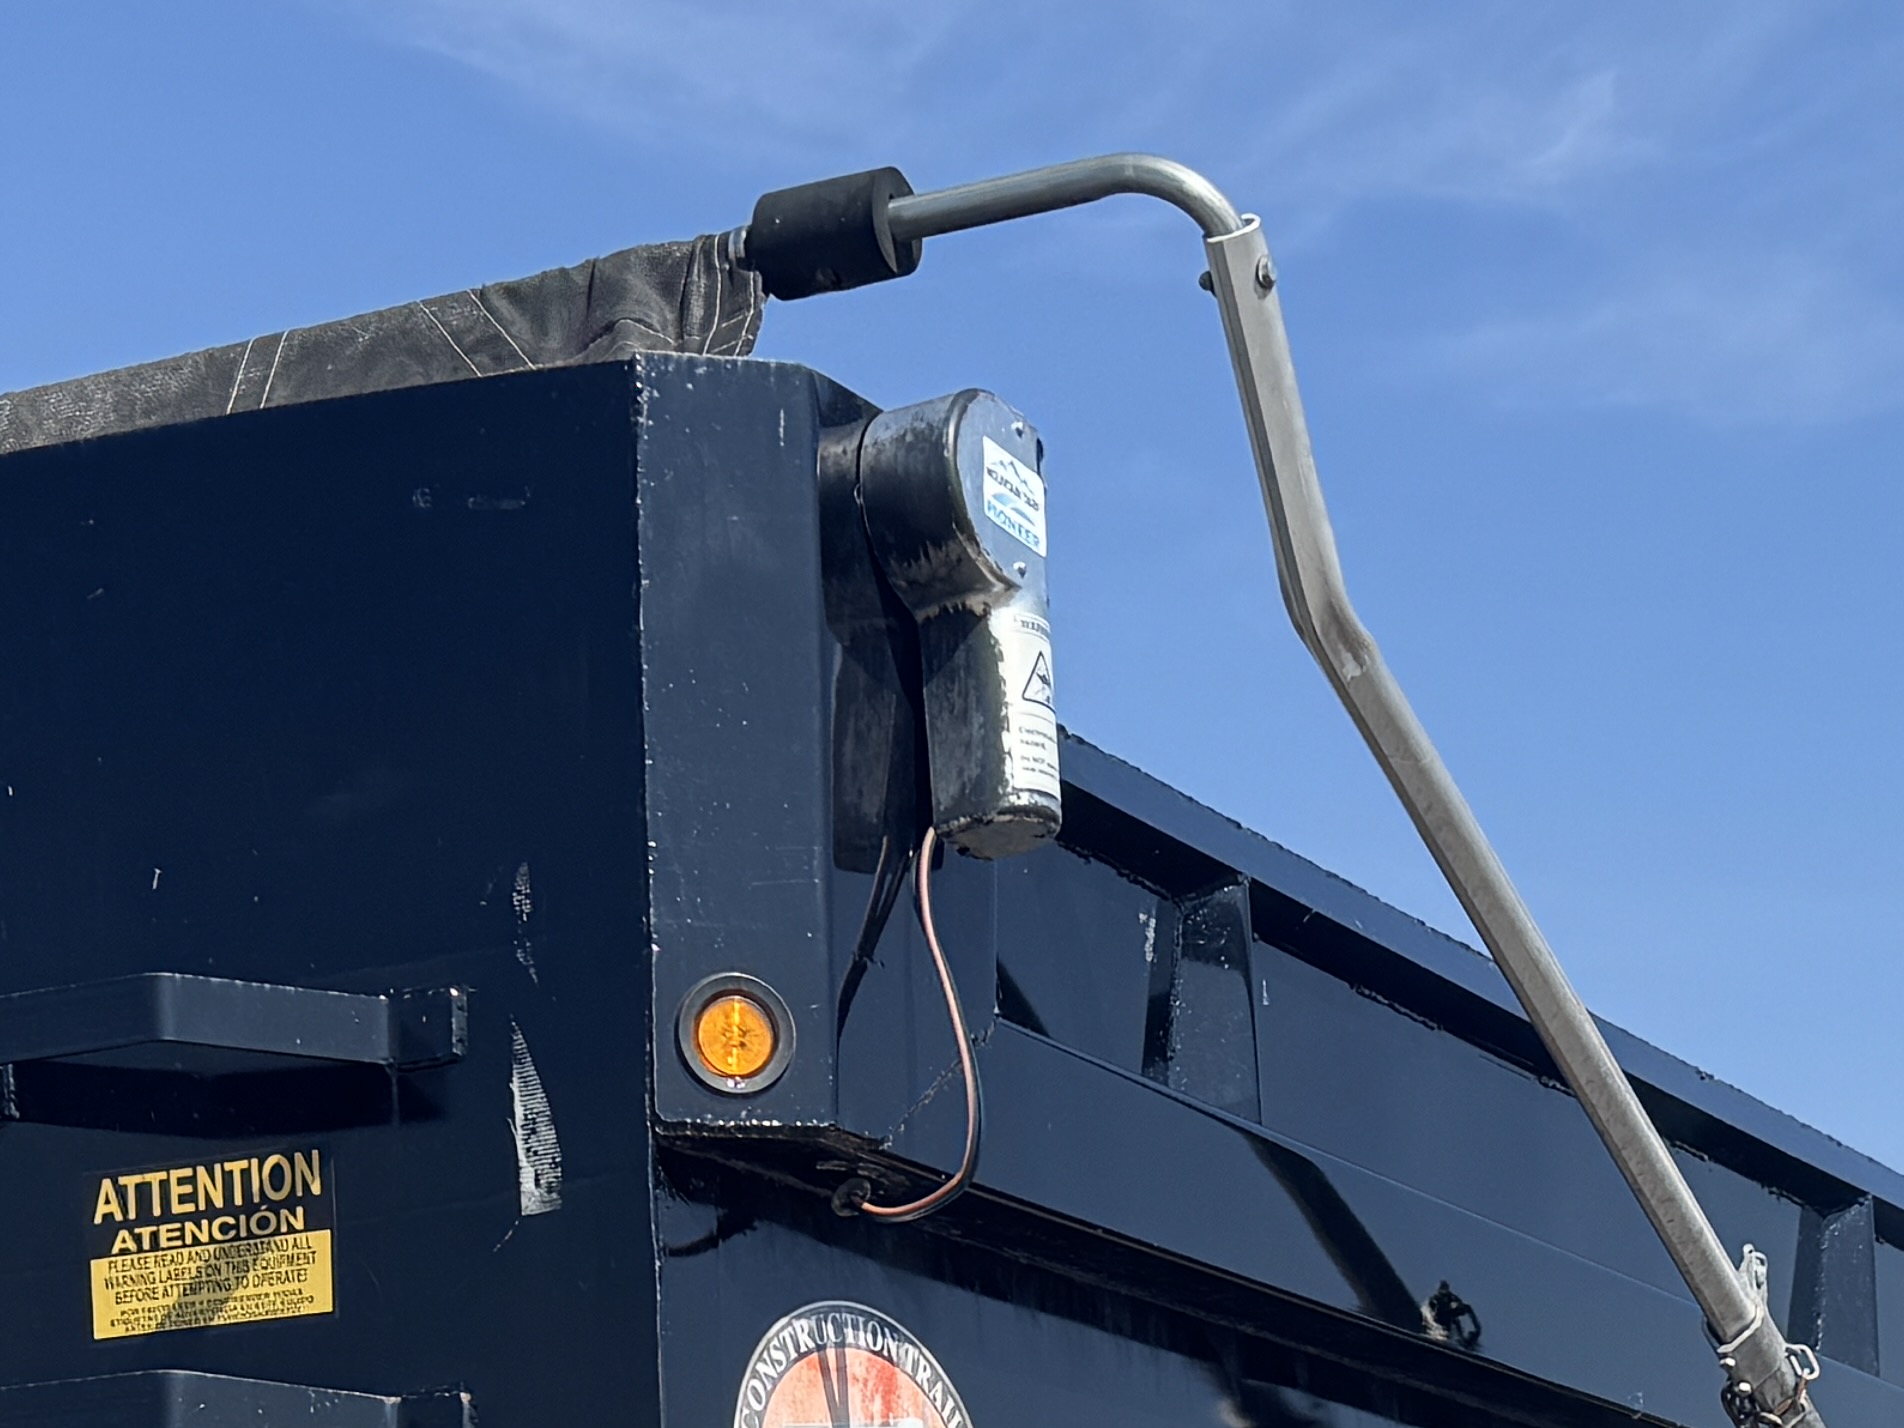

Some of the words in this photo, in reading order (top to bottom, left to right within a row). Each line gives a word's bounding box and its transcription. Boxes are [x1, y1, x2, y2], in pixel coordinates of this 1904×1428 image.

[93, 1149, 322, 1225] ATTENTION
[111, 1205, 305, 1254] ATENCIÓN
[104, 1270, 156, 1290] WARNING
[158, 1265, 203, 1284] LABELS
[205, 1262, 222, 1278] ON
[252, 1250, 316, 1271] EQUIPMENT
[108, 1255, 151, 1274] PLEASE
[153, 1251, 184, 1268] READ
[187, 1247, 212, 1264] AND
[291, 1235, 312, 1250] ALL
[115, 1285, 159, 1305] BEFORE
[162, 1277, 232, 1299] ATTEMPTING
[234, 1274, 250, 1290] TO
